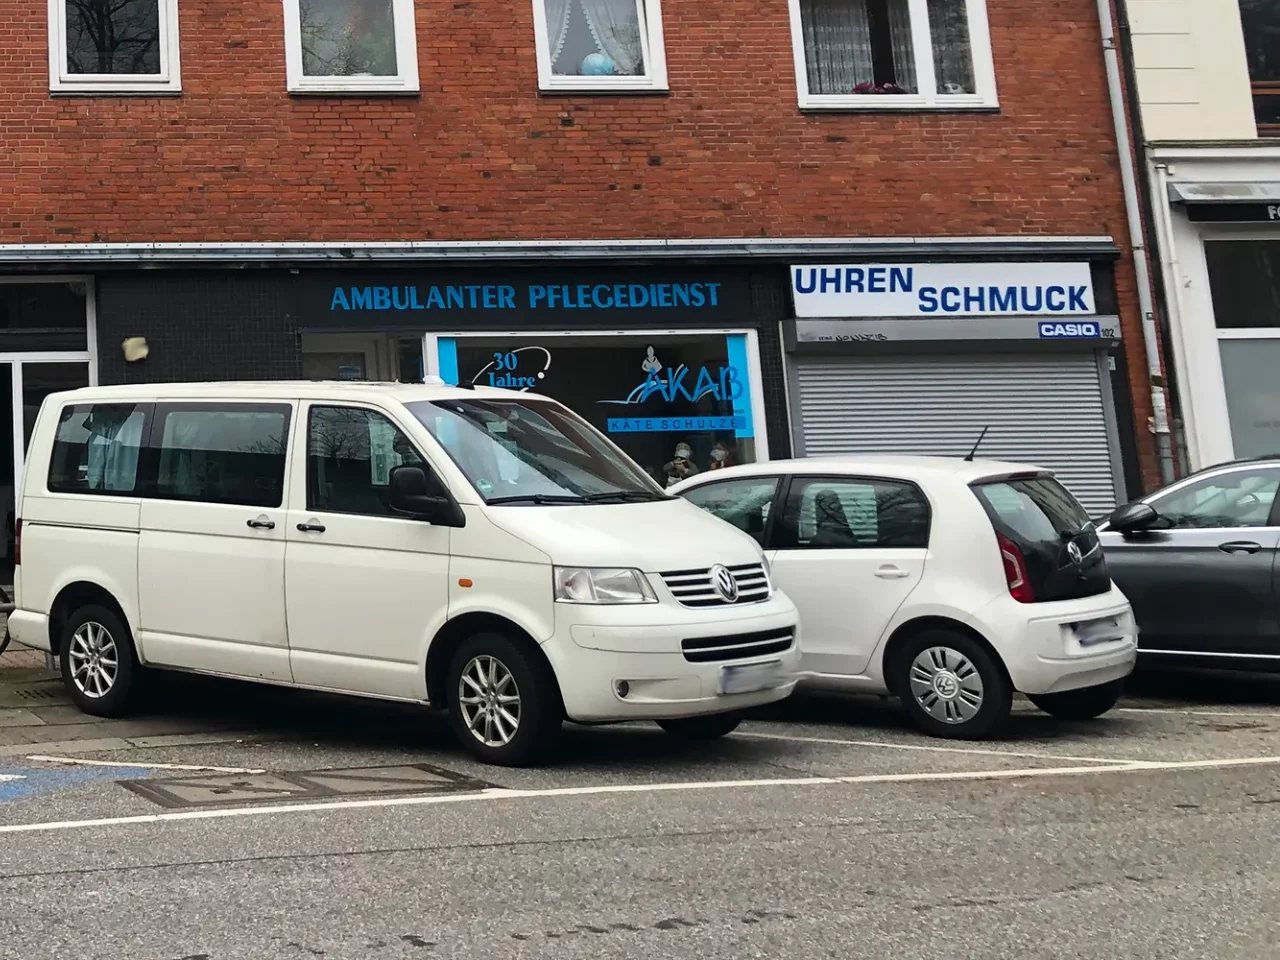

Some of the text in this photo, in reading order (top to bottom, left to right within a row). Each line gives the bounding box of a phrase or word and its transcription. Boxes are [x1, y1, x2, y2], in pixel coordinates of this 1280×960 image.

[795, 267, 913, 294] UHREN
[330, 283, 721, 311] AMBULANTER PFLEGEDIENST
[918, 285, 1089, 313] SCHMUCK
[1040, 323, 1096, 337] CASIO
[493, 352, 518, 371] 30
[487, 371, 536, 388] Jahre
[661, 418, 738, 430] SCHULZE
